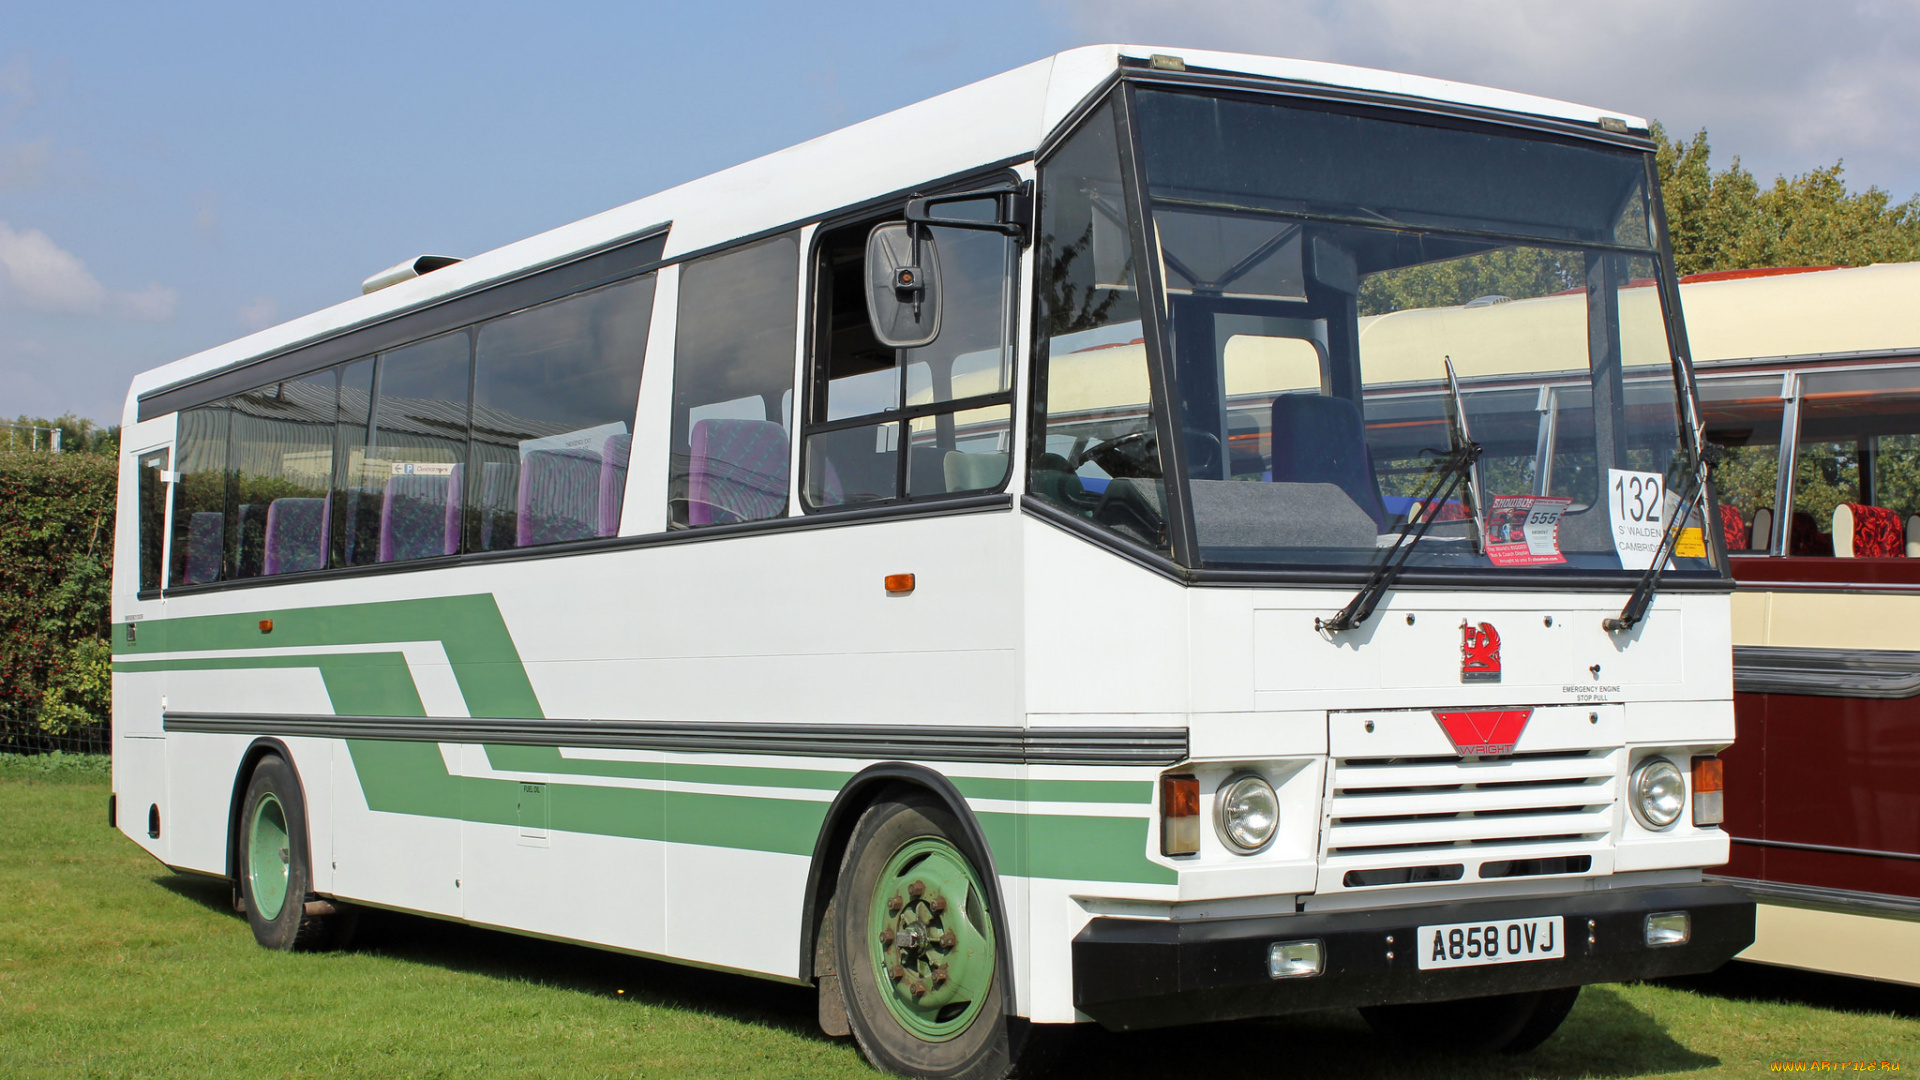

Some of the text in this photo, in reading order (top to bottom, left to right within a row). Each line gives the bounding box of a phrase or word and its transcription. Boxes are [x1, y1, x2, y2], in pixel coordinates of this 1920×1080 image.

[1493, 498, 1534, 508] SHOWBUS
[1615, 475, 1660, 522] 132
[1530, 512, 1558, 524] 555
[1627, 527, 1662, 538] WALDEN
[1459, 744, 1514, 755] WRIGHT
[1432, 921, 1554, 961] A858 OVJ
